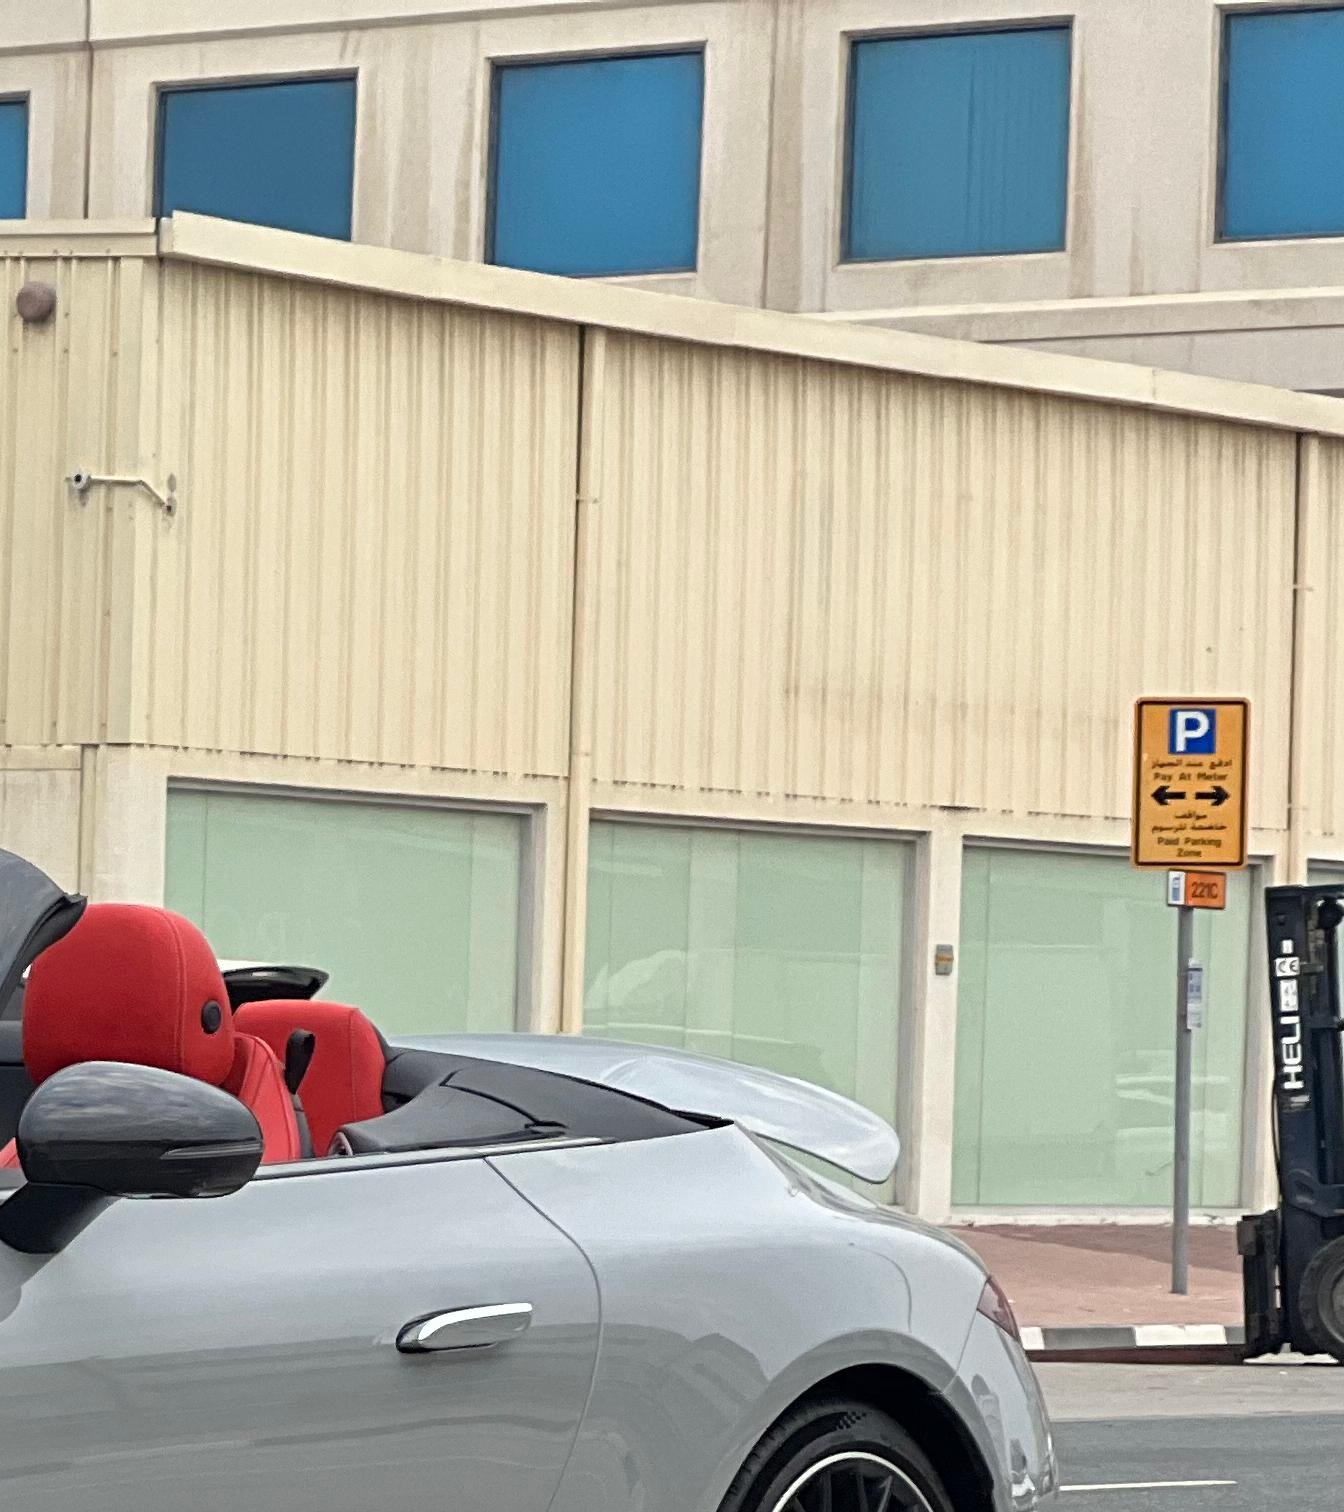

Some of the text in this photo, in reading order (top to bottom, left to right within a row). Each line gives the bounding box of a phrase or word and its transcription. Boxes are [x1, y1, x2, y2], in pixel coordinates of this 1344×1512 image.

[1176, 711, 1210, 752] P
[1153, 772, 1228, 782] Pay At Meter
[1157, 836, 1222, 848] Paid Parking
[1176, 847, 1202, 857] Zone
[1191, 881, 1218, 899] 221C
[1280, 1016, 1304, 1089] HELI
